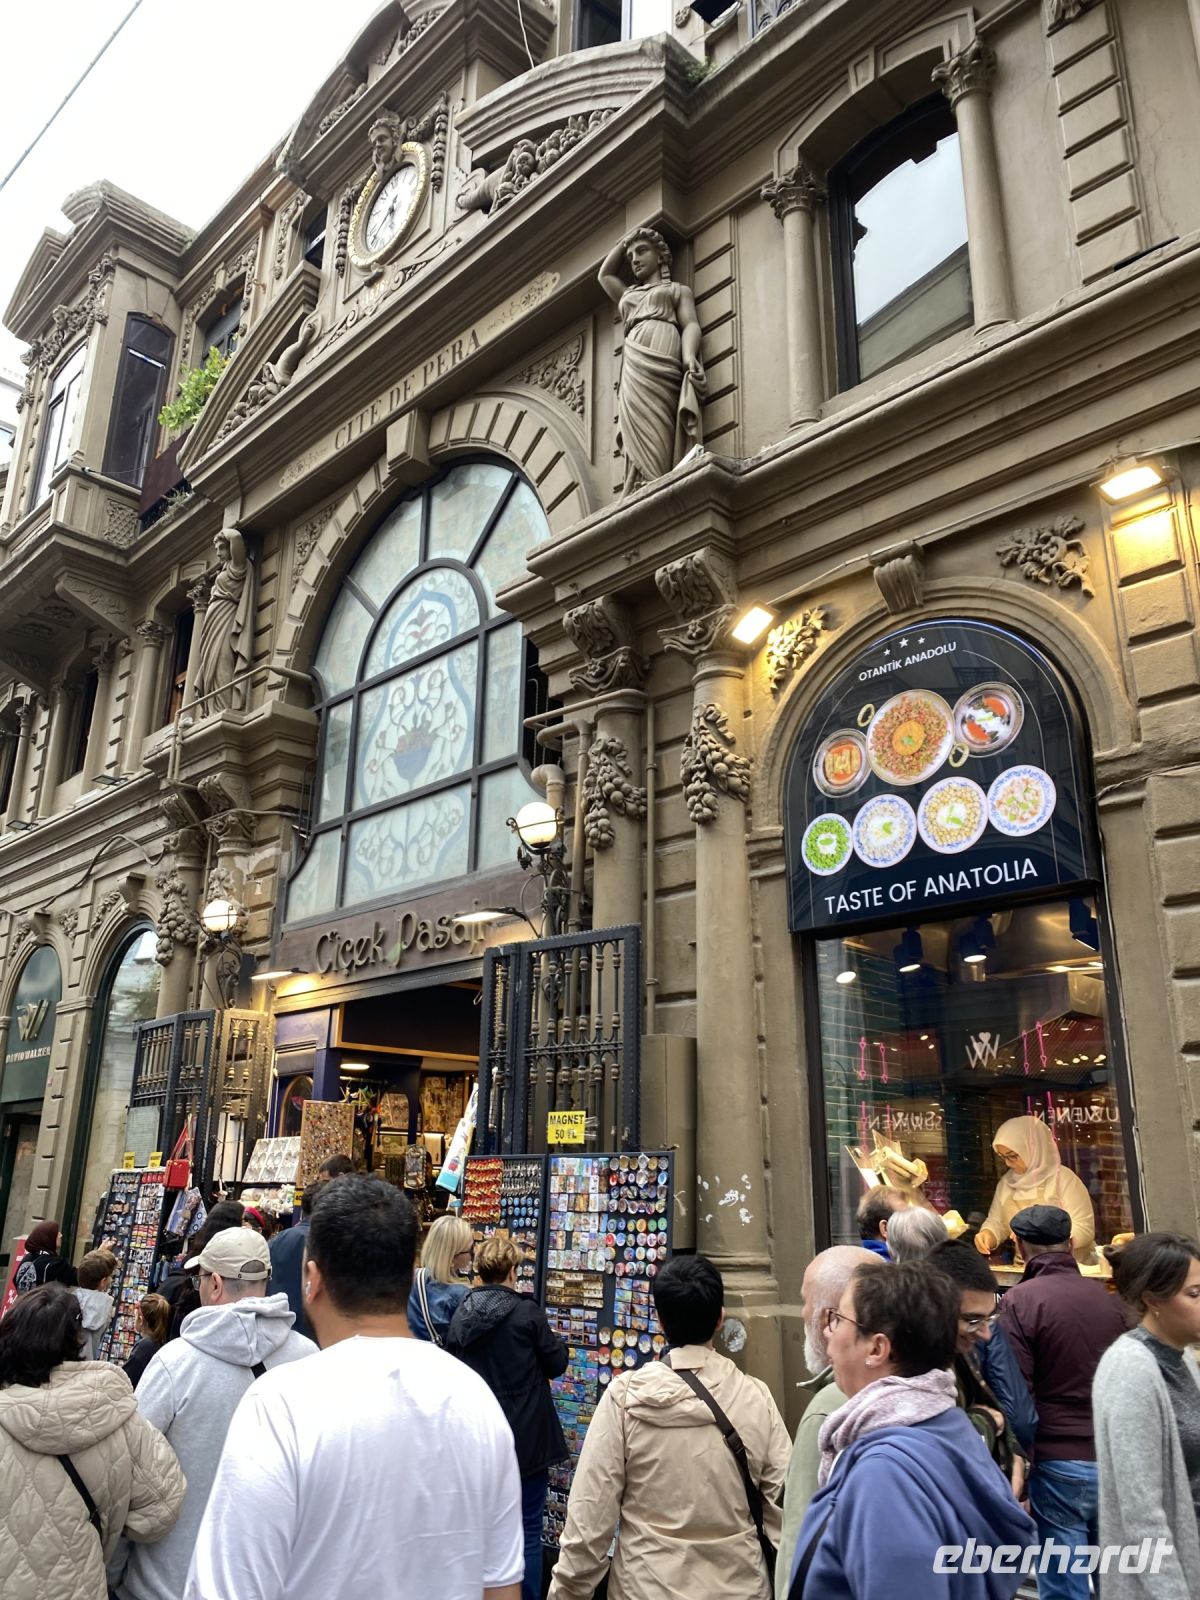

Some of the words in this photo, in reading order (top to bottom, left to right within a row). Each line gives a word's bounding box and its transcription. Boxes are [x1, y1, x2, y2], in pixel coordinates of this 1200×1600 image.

[335, 400, 381, 450] CITE
[390, 374, 415, 412] DE
[423, 329, 481, 387] PERA
[859, 660, 902, 681] OTANTİK
[904, 642, 957, 667] ANADOLU
[824, 887, 883, 915] TASTE
[889, 880, 917, 903] OF
[924, 858, 1038, 897] ANATOLIA
[550, 1114, 584, 1125] MAGNET
[555, 1129, 565, 1139] 50
